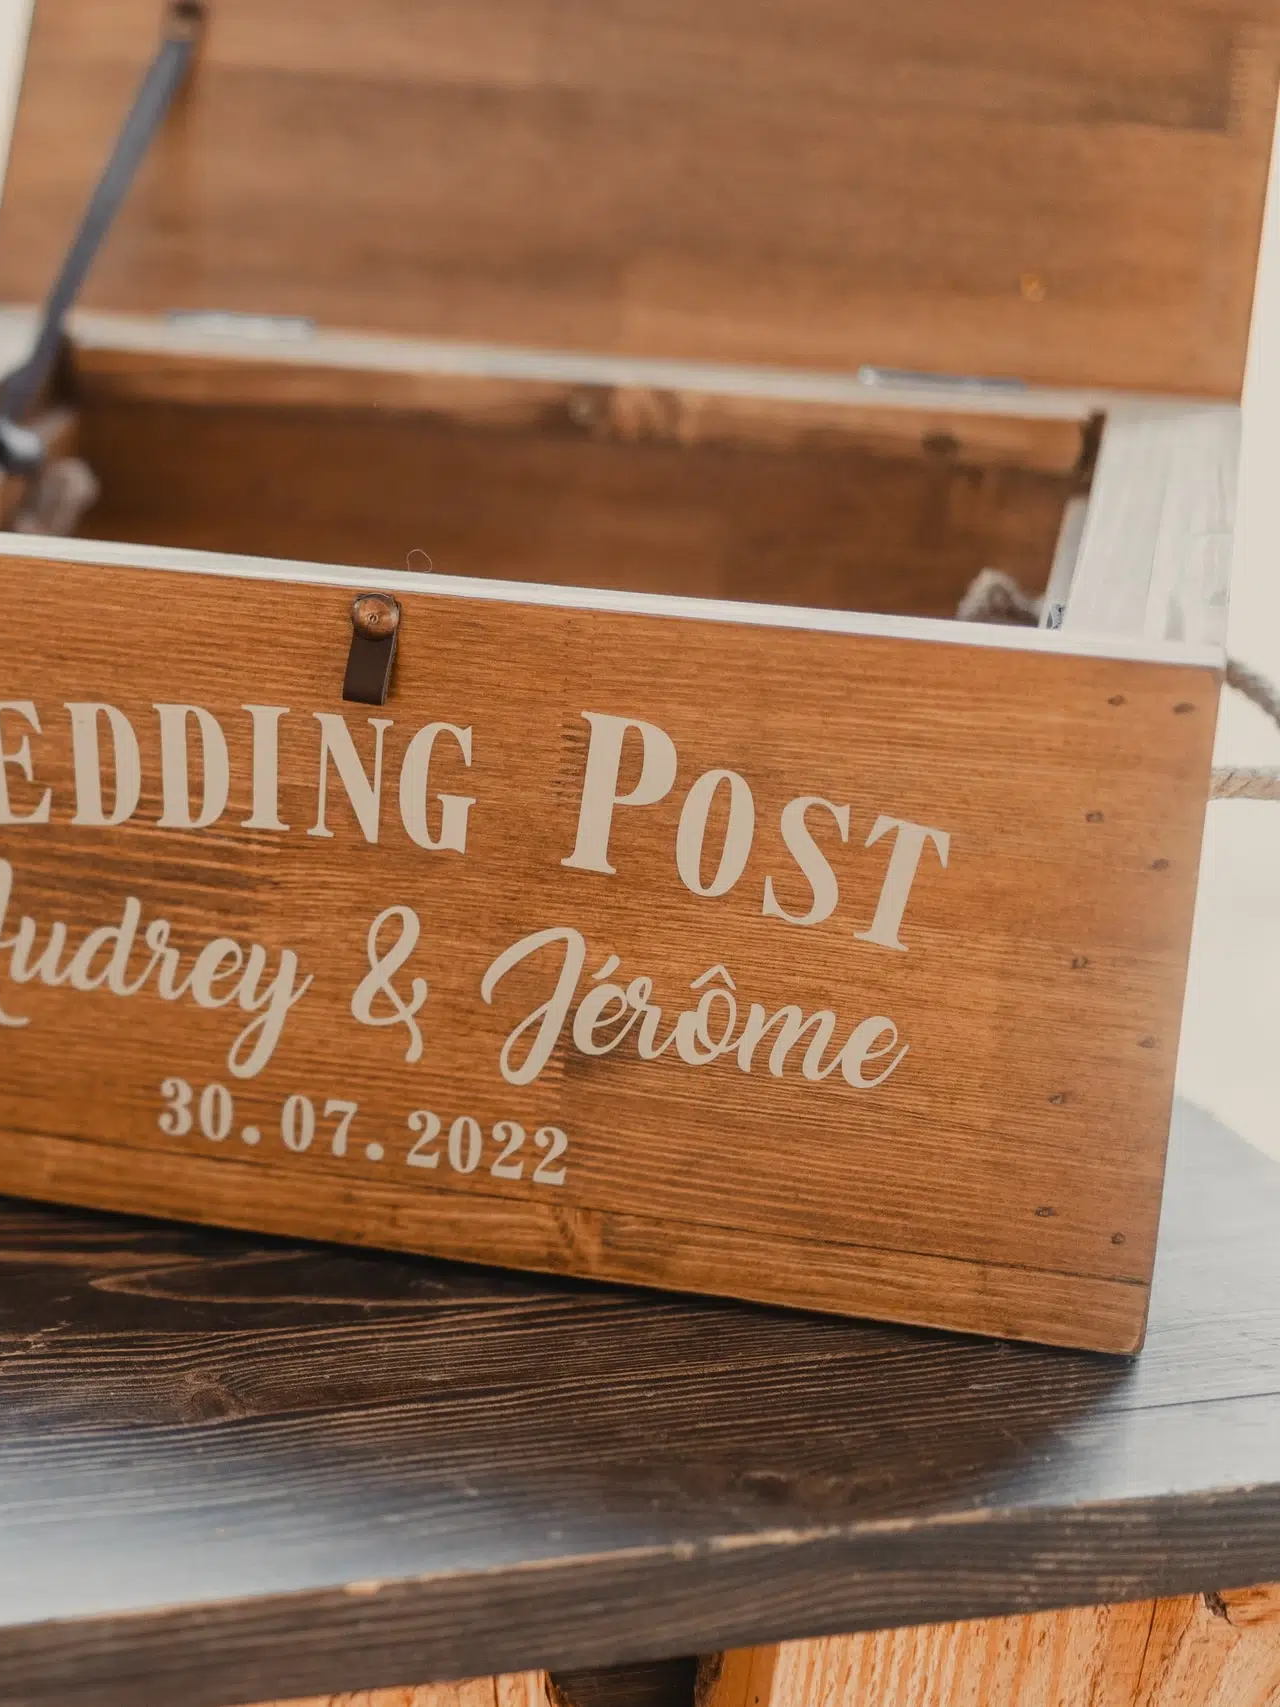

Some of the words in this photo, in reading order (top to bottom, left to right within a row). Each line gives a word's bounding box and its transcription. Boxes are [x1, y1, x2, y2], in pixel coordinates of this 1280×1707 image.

[560, 711, 952, 952] POST
[351, 905, 428, 1062] &
[481, 927, 910, 1089] Jérôme
